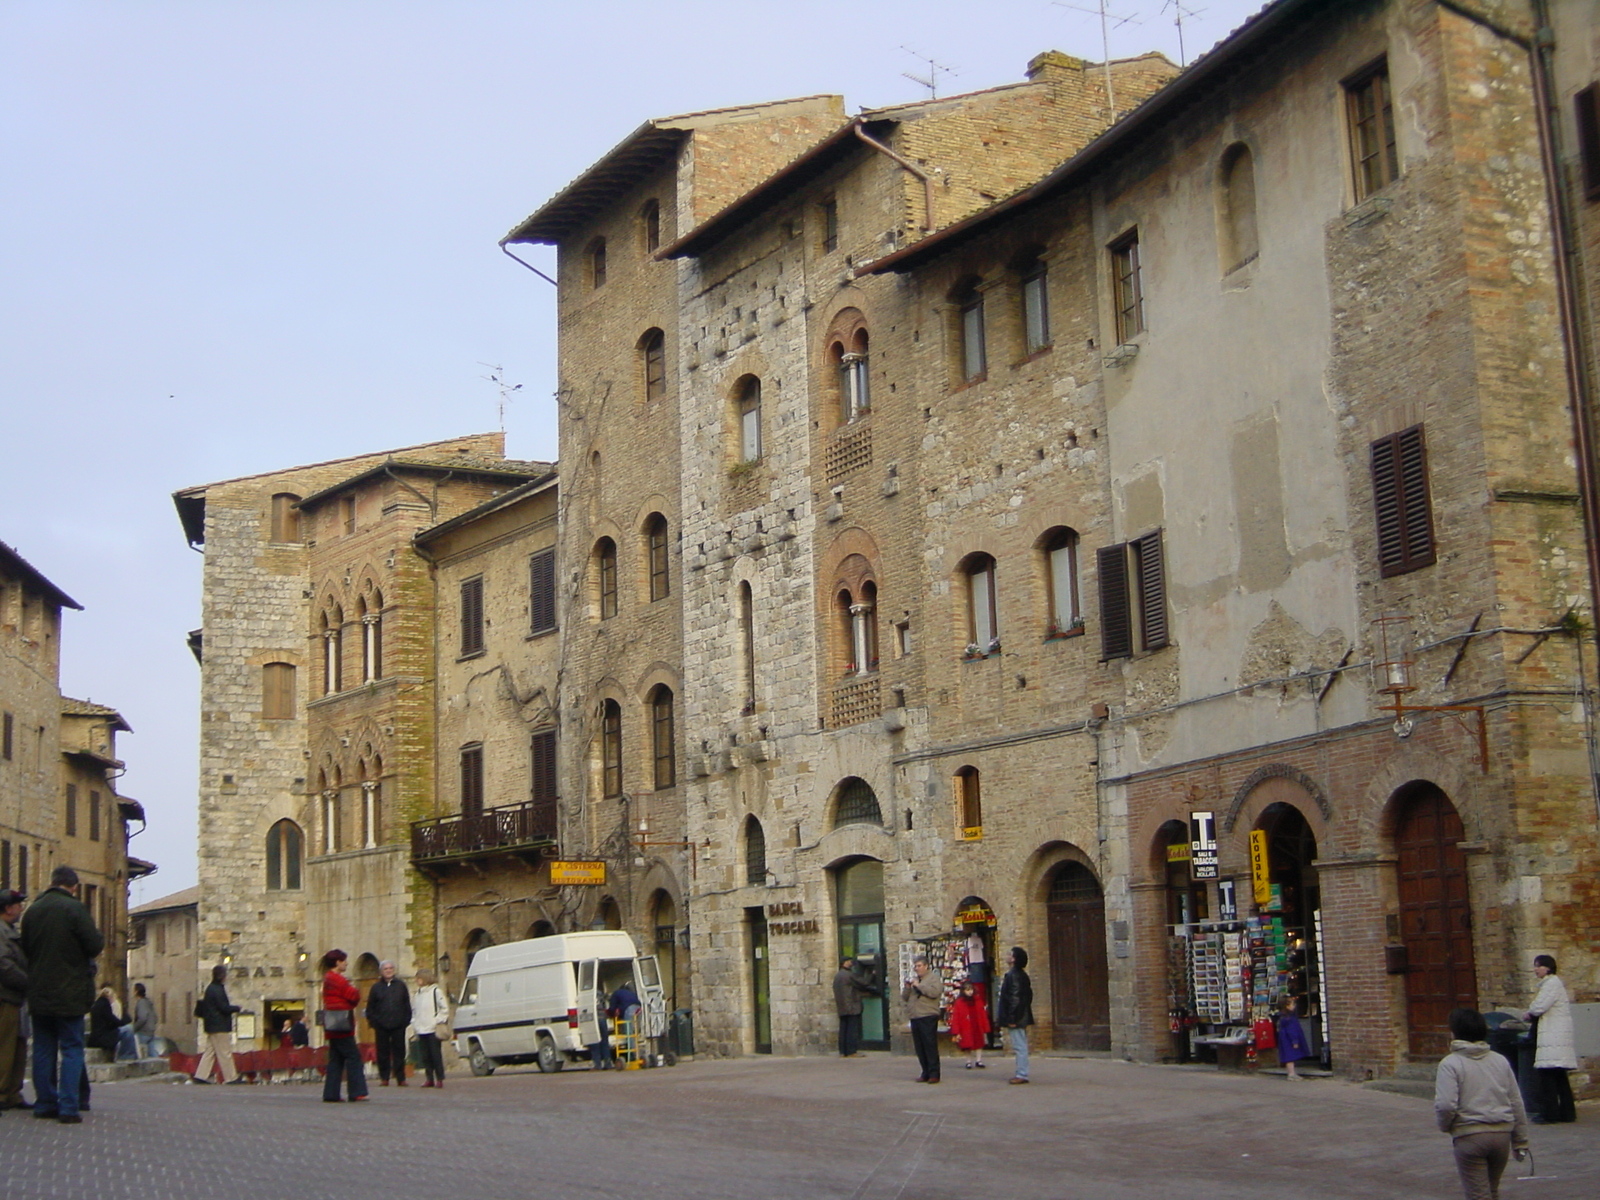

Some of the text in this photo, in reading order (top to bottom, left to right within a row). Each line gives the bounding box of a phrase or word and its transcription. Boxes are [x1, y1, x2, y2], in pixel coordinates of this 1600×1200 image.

[1192, 812, 1212, 850] T
[1193, 857, 1218, 865] TABACCHI
[1252, 834, 1261, 881] Kodak
[769, 902, 803, 917] BANCA
[963, 911, 985, 921] Kodak
[769, 919, 819, 936] TOSCANA
[235, 967, 284, 977] BAR
